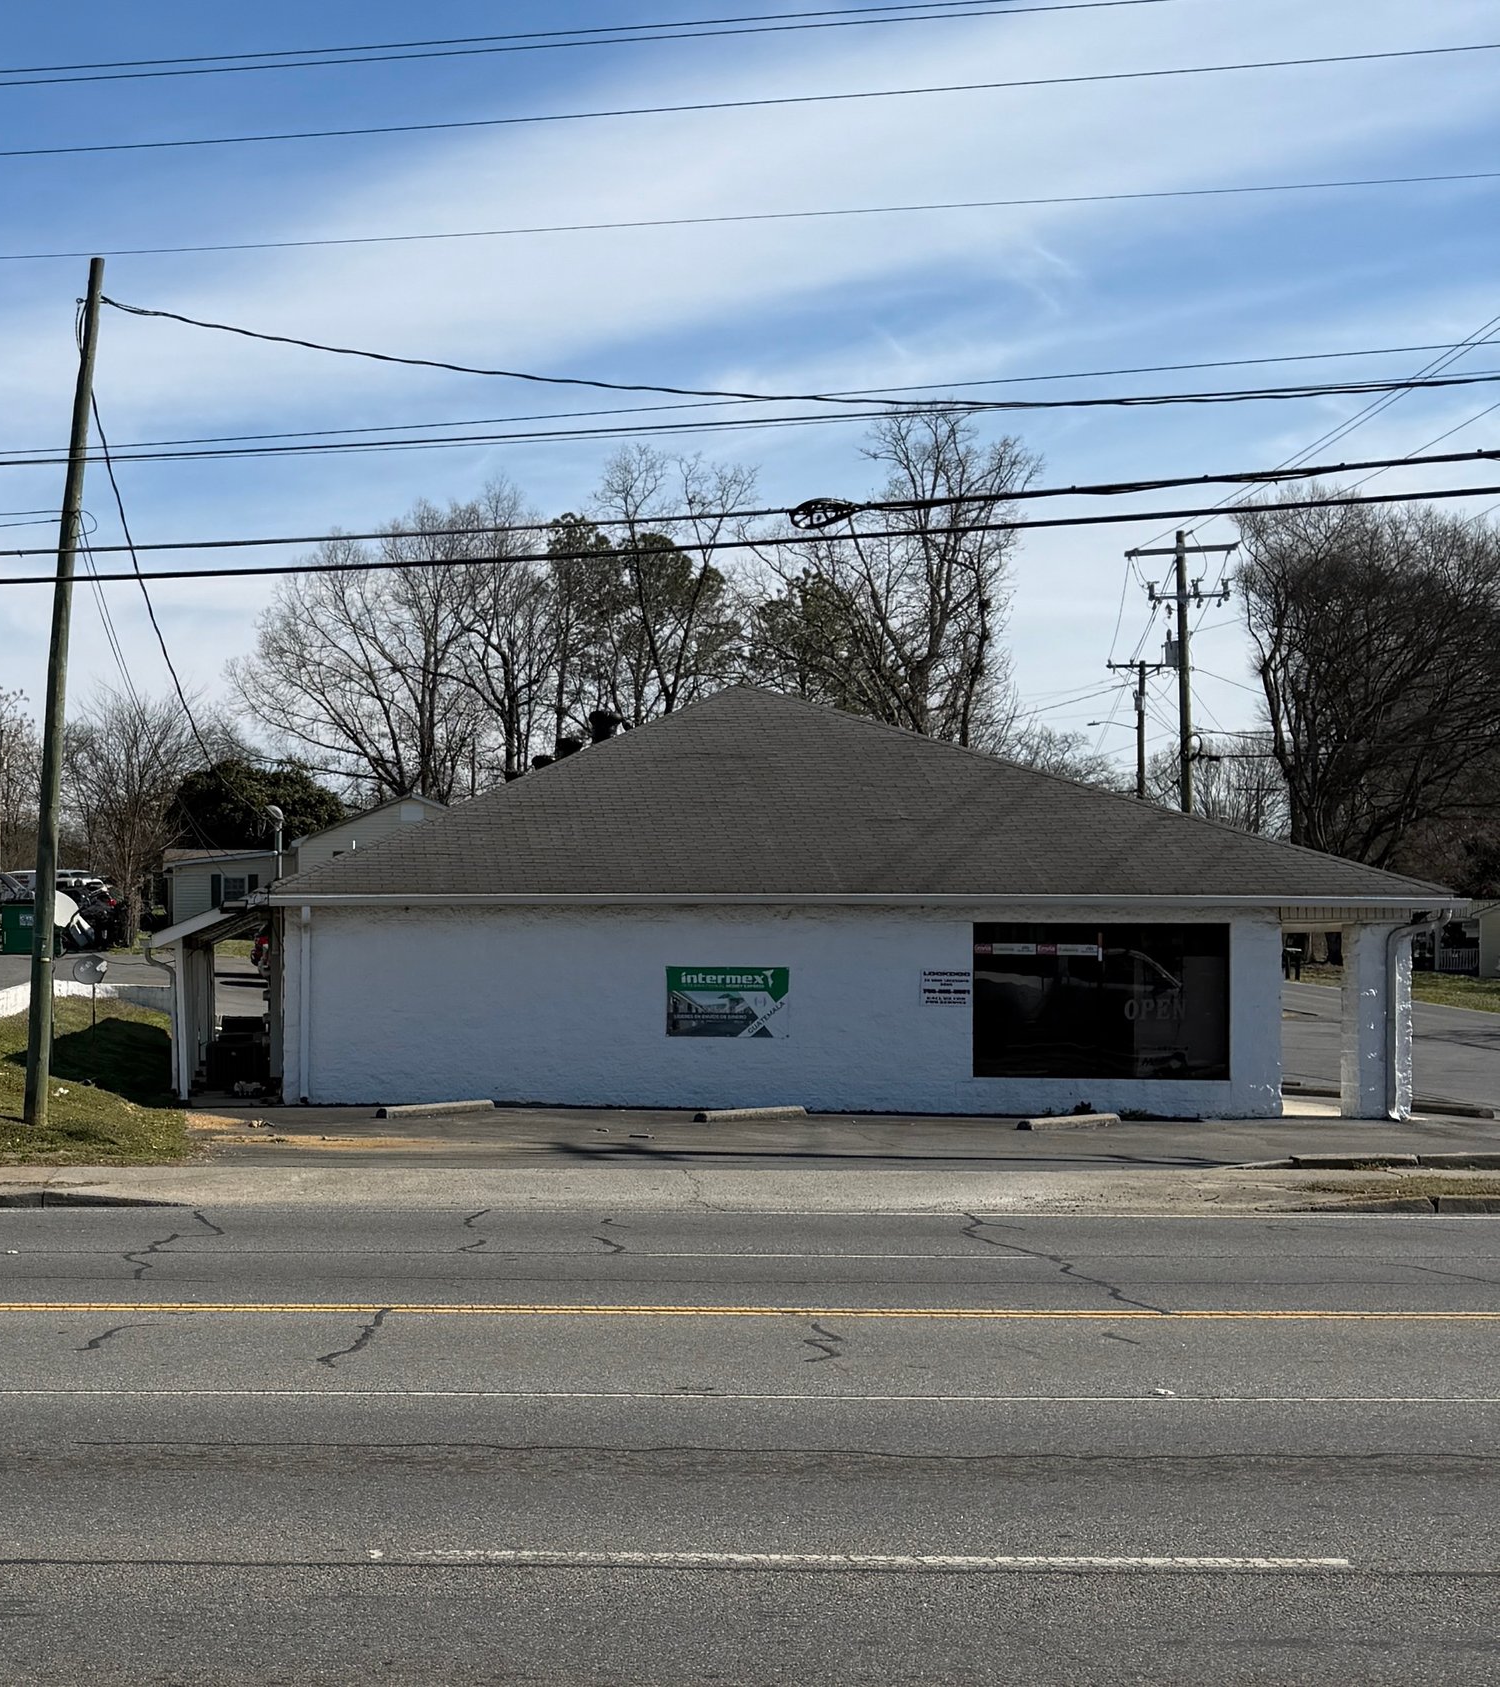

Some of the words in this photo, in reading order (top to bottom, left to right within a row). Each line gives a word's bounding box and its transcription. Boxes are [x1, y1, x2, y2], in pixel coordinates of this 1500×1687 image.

[681, 971, 765, 984] intermex
[747, 1001, 786, 1034] GUATEMALA
[1124, 999, 1187, 1021] OPEN
